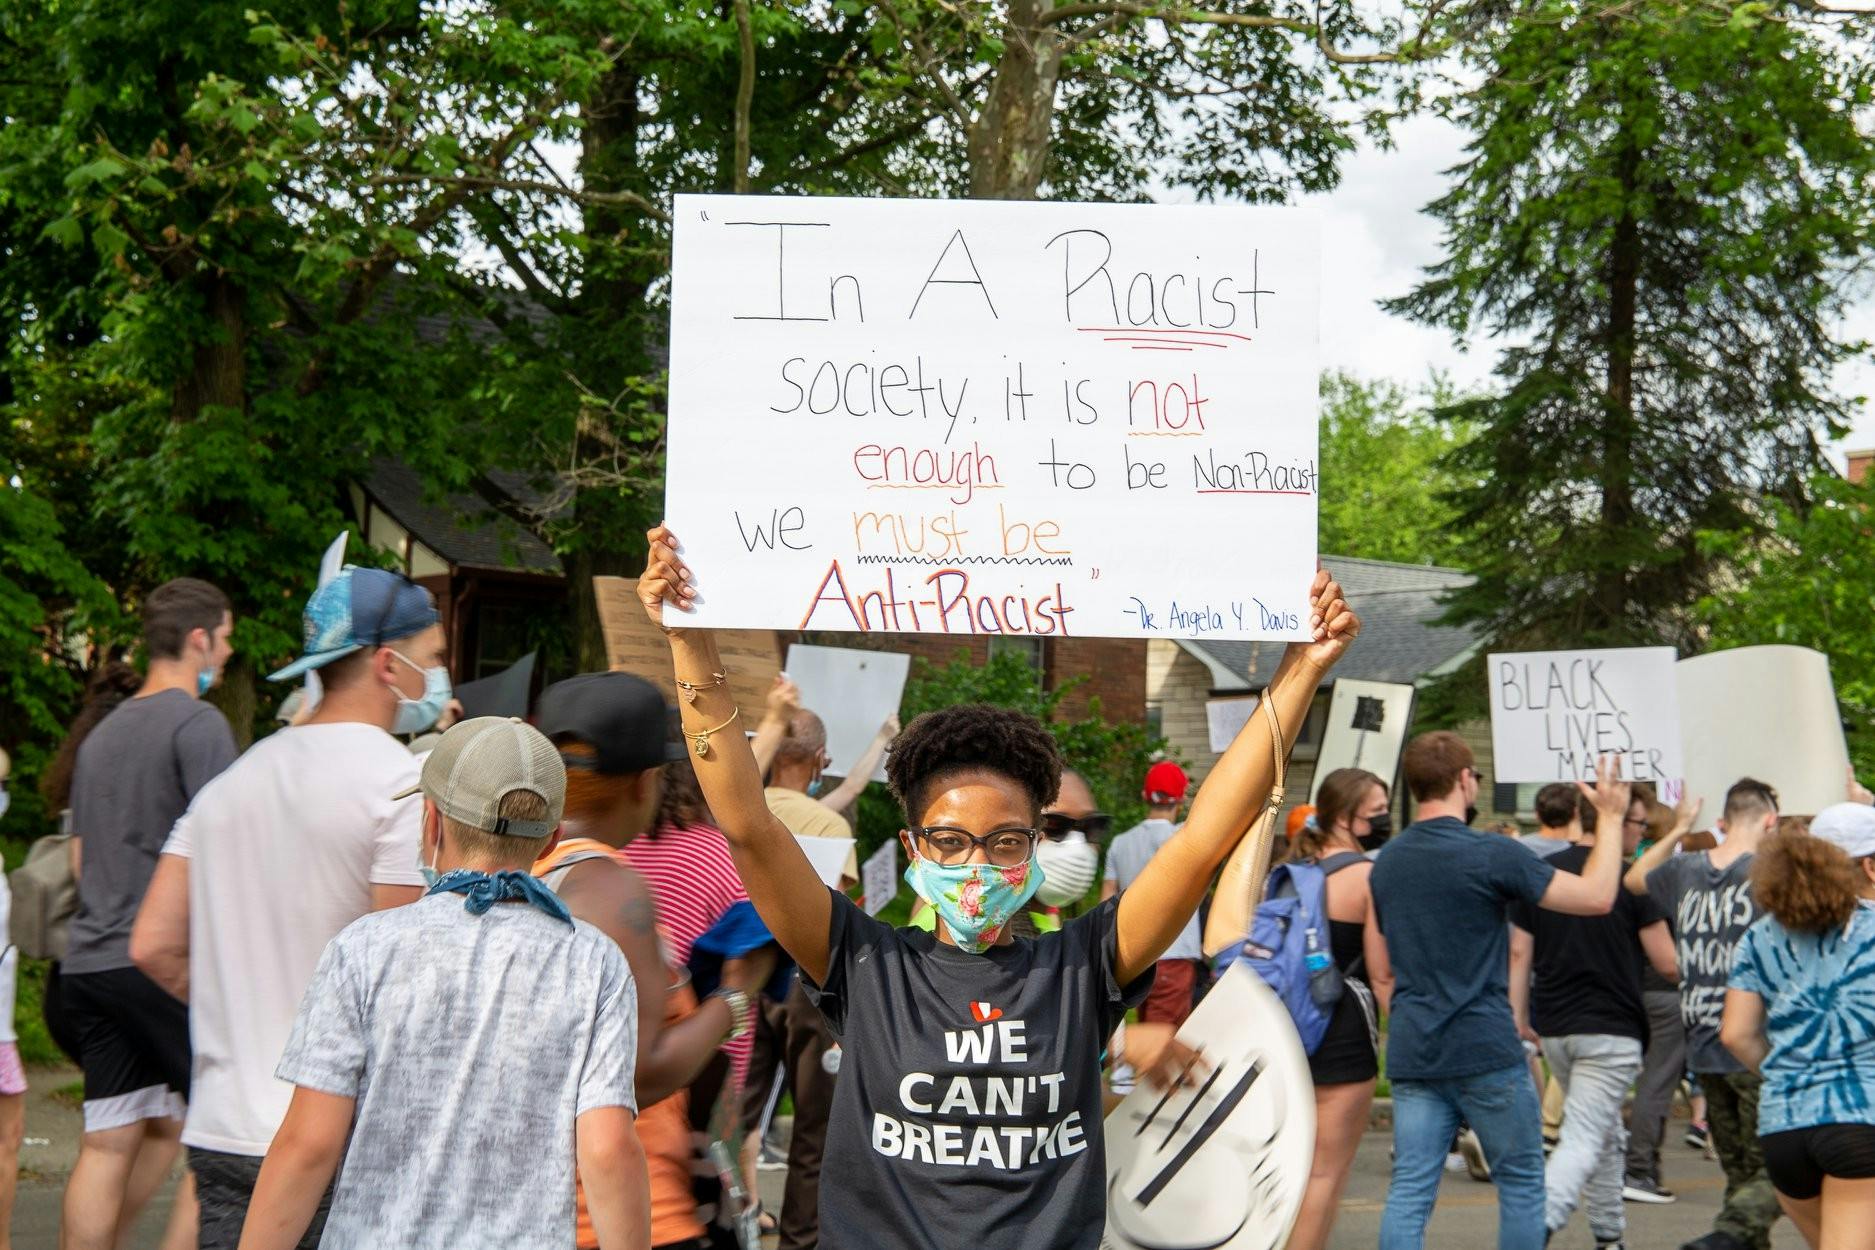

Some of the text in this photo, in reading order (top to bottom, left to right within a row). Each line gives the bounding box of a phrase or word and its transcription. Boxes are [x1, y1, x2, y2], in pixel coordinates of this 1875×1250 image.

[909, 229, 999, 320] A
[1045, 229, 1275, 329] Racist
[770, 350, 1209, 444] society, it is not
[854, 438, 1319, 505] enough to be Non-Racist
[735, 502, 1071, 559] we must be
[1169, 601, 1223, 637] Angela
[1231, 601, 1249, 631] Y.
[1252, 597, 1299, 631] Davis
[1501, 659, 1617, 711] BLACK
[1546, 711, 1633, 755] LIVES
[1677, 879, 1754, 935] OLVES
[945, 1020, 1028, 1064] WE
[899, 1071, 1065, 1116] CAN'T
[872, 1111, 1088, 1170] BREATHE
